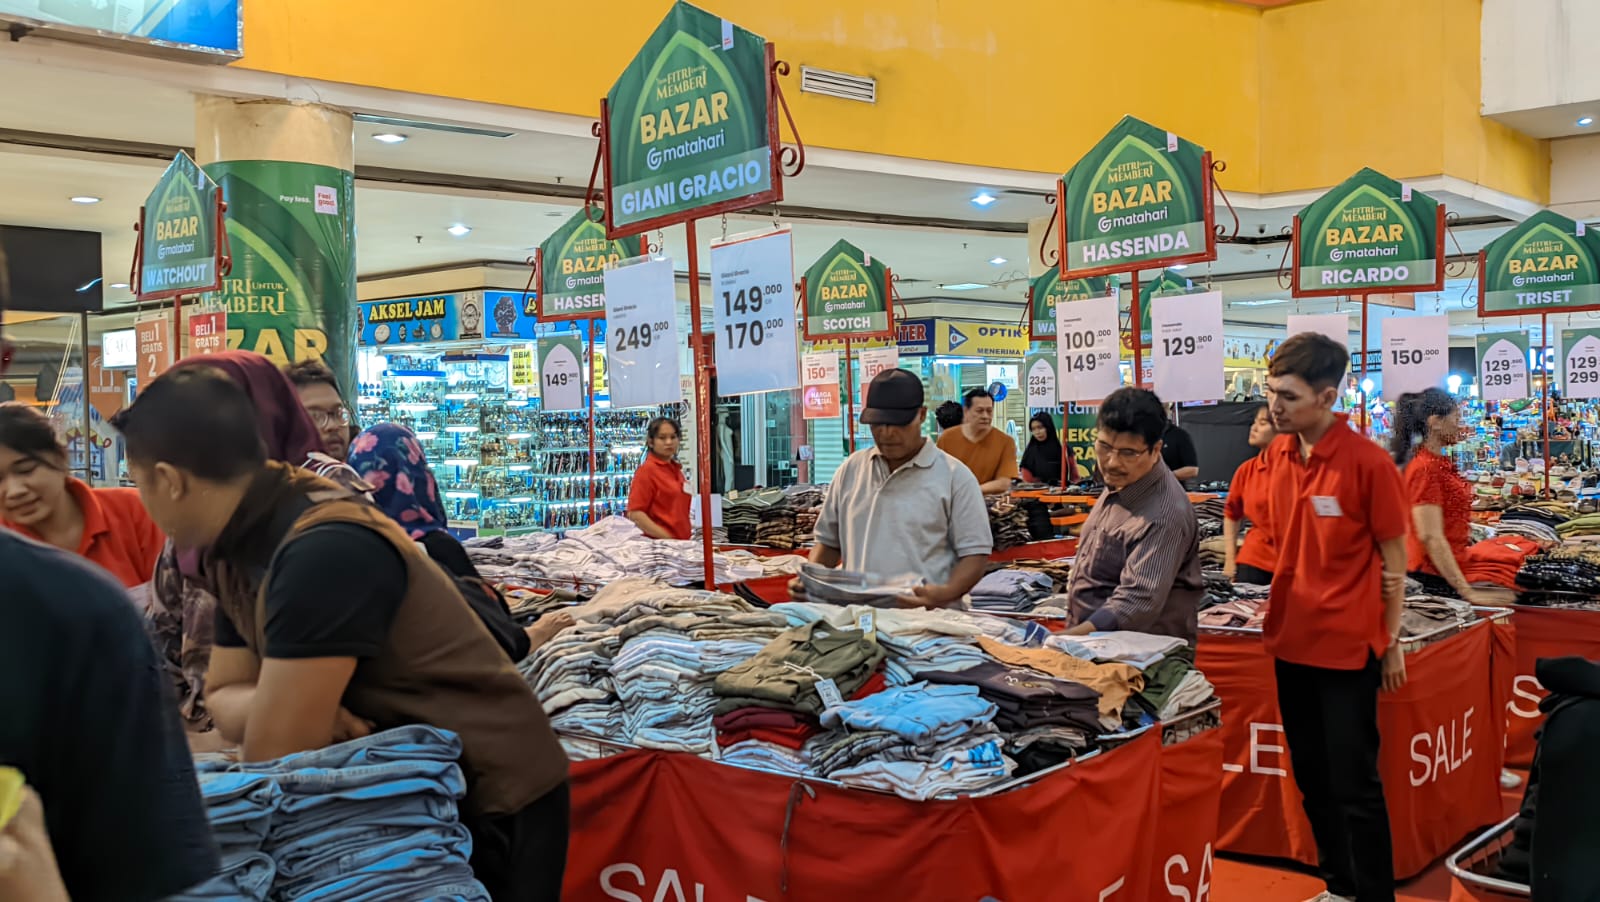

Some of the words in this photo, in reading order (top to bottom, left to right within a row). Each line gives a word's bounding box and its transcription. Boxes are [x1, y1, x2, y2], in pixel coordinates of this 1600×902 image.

[657, 71, 707, 101] MEMBERI
[640, 91, 729, 145] BAZAR
[663, 128, 725, 162] matahari
[621, 182, 676, 215] GIANI
[679, 160, 761, 201] GRACIO
[1093, 180, 1172, 214] BAZAR
[1113, 206, 1167, 227] matahari
[156, 216, 198, 241] BAZAR
[1326, 224, 1404, 246] BAZAR
[1083, 231, 1189, 263] HASSENDA
[1345, 245, 1398, 258] matahari
[1509, 255, 1578, 274] BAZAR
[146, 264, 207, 286] WATCHOUT
[1321, 266, 1409, 285] RICARDO
[1526, 272, 1574, 284] matahari
[821, 284, 867, 300] BAZAR
[1516, 290, 1573, 305] TRISET
[369, 302, 413, 321] AKSEL
[415, 299, 445, 319] JAM
[554, 294, 606, 311] HASSEN
[141, 331, 154, 343] BELI
[154, 323, 160, 341] 1
[195, 325, 211, 336] BELI
[211, 316, 216, 334] 1
[823, 317, 871, 331] SCOTCH
[978, 327, 1022, 338] OPTIK
[141, 342, 163, 354] GRATIS
[195, 336, 219, 348] GRATIS
[977, 347, 1020, 356] MENERIMA
[148, 354, 157, 377] 2
[1409, 707, 1474, 787] SALE
